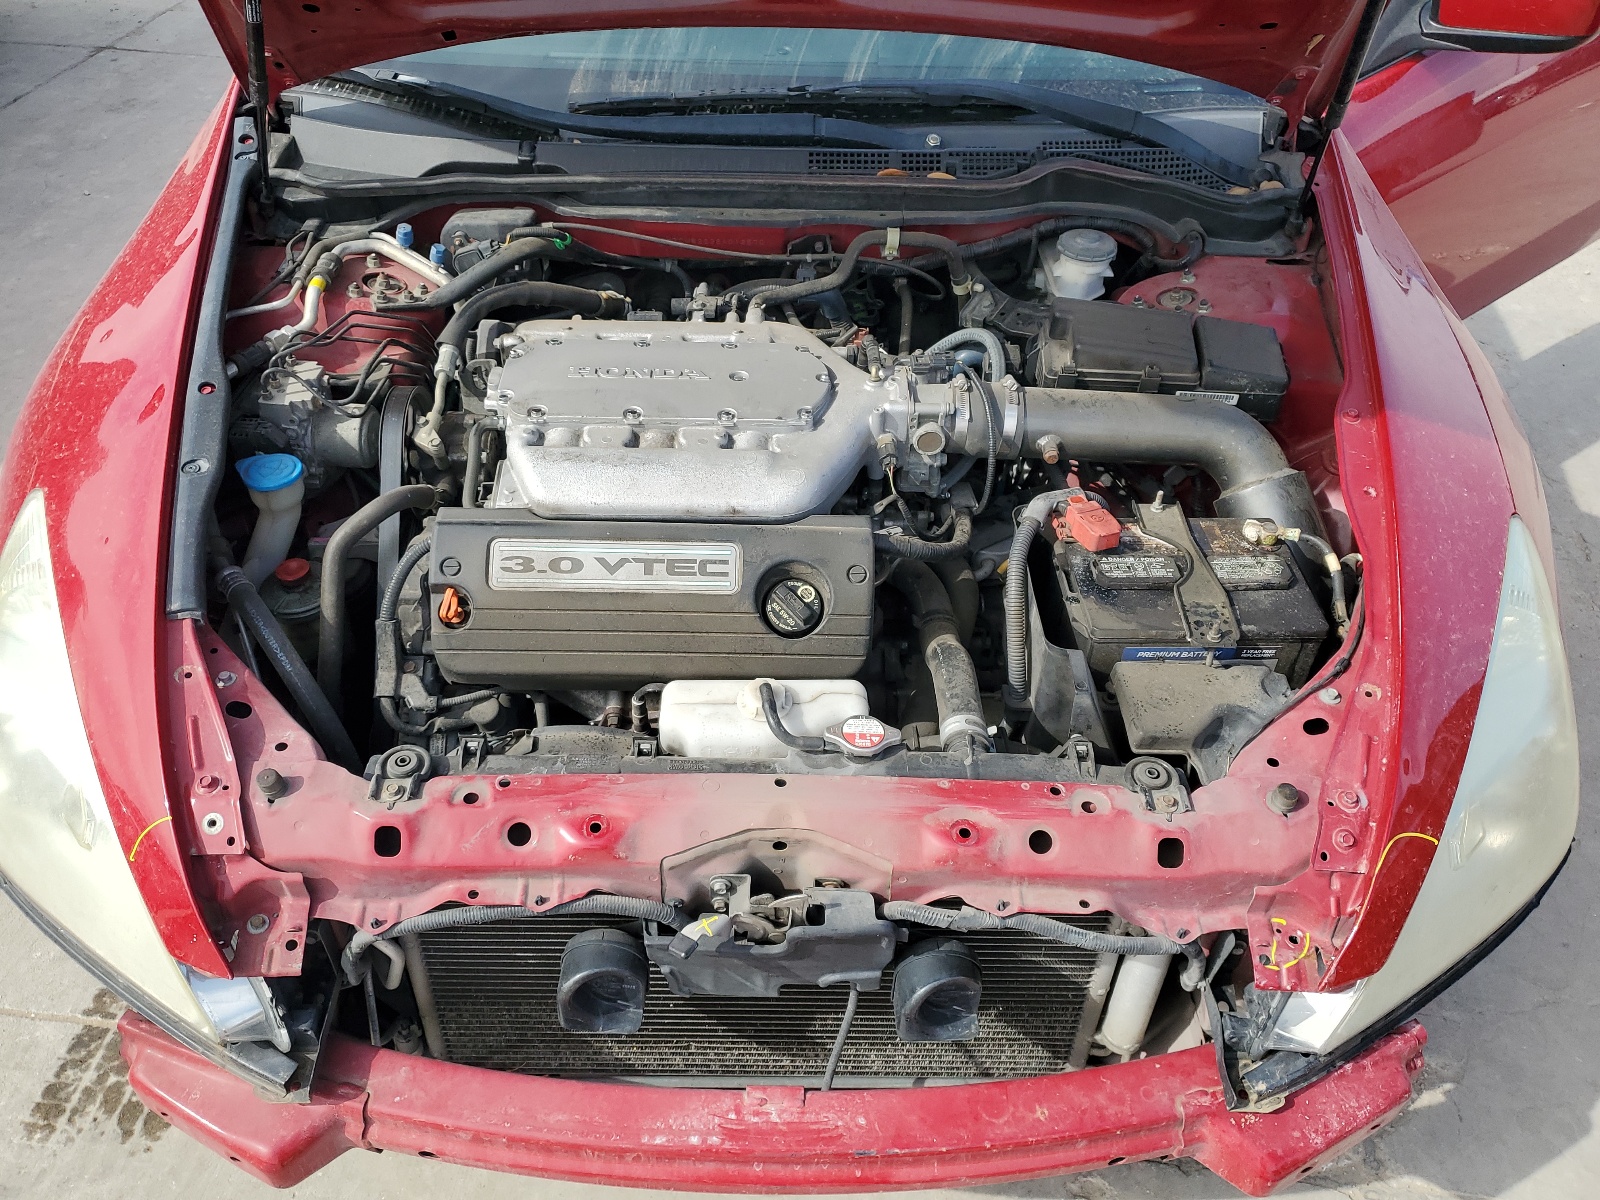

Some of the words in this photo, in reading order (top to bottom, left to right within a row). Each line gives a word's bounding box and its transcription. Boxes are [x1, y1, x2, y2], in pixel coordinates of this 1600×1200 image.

[567, 365, 712, 380] HONDA
[499, 555, 585, 574] 3.0
[593, 556, 730, 578] VTEC
[771, 602, 781, 612] SAE
[779, 608, 796, 626] 5W-20
